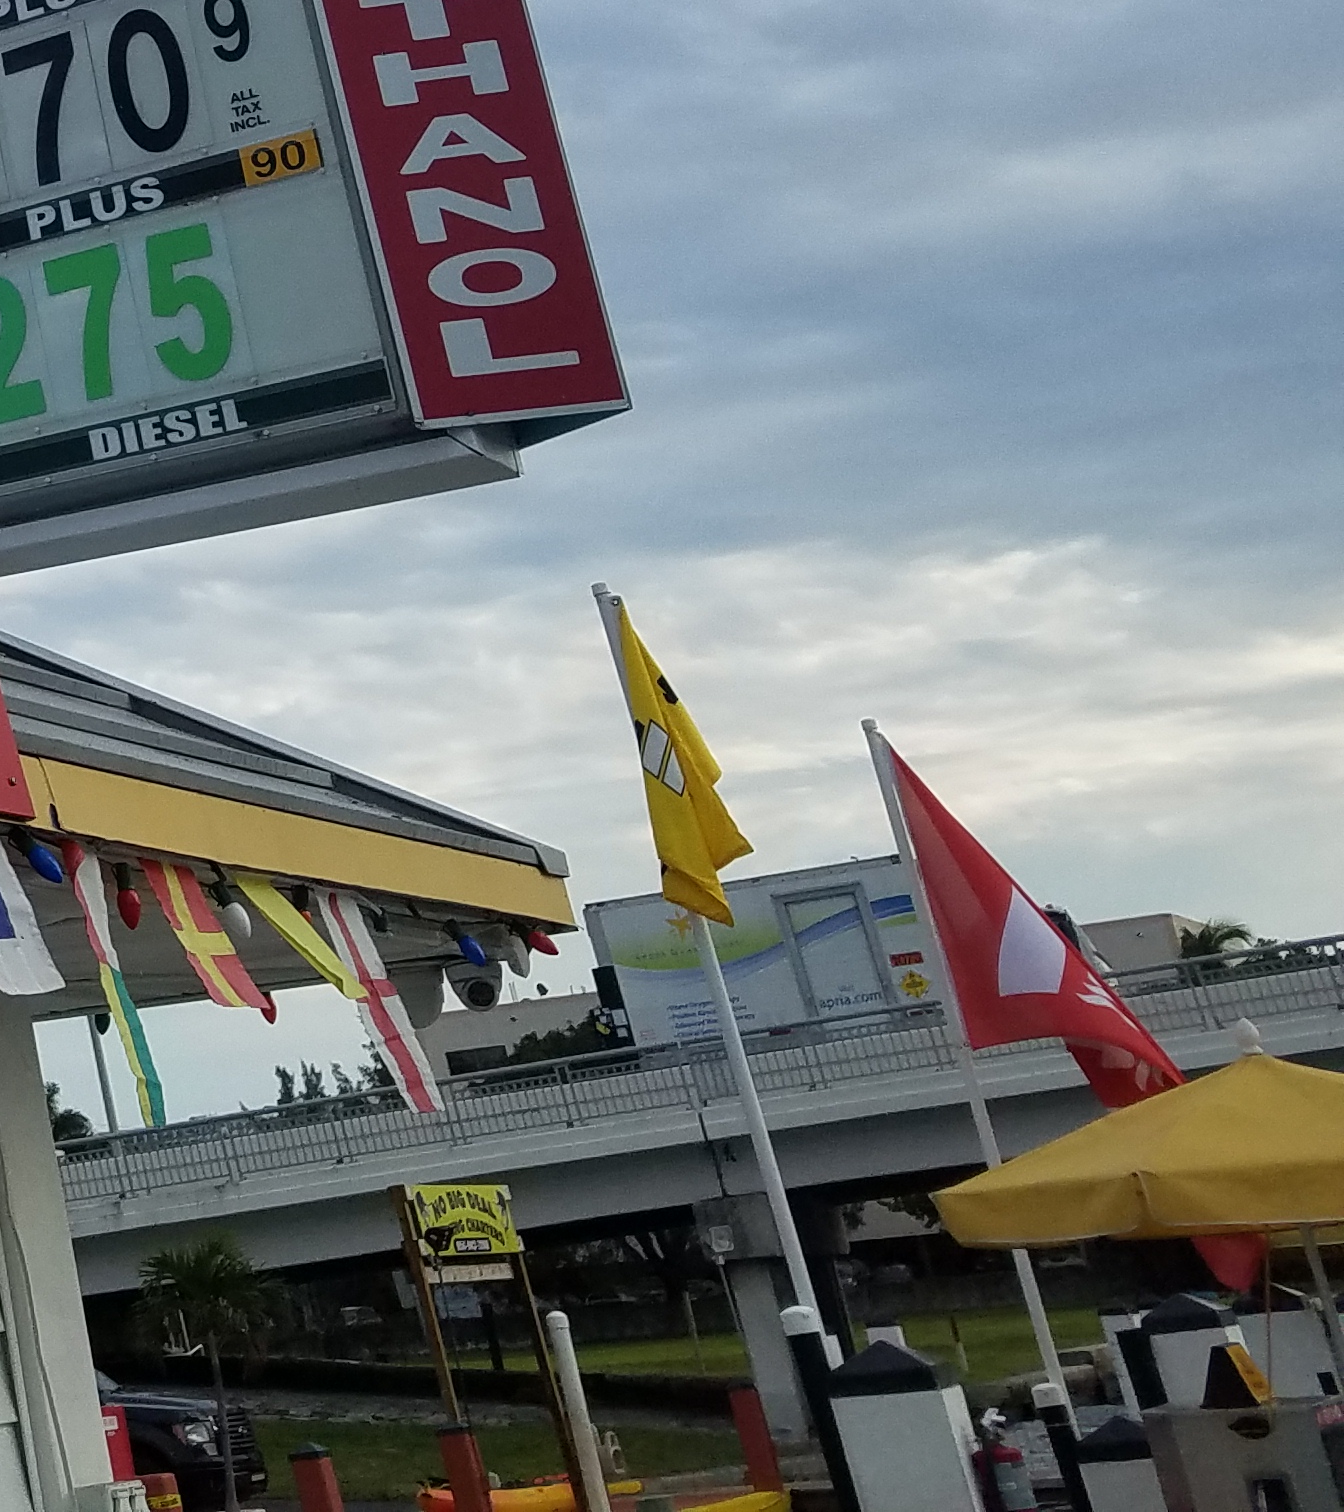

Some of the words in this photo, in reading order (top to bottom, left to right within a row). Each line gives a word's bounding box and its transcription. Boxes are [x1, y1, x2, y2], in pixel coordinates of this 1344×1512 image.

[230, 88, 260, 105] ALL
[231, 100, 262, 118] TAX
[230, 116, 271, 133] INCL.
[28, 177, 165, 242] PLUS
[251, 140, 306, 178] 90
[90, 399, 248, 462] DIESEL
